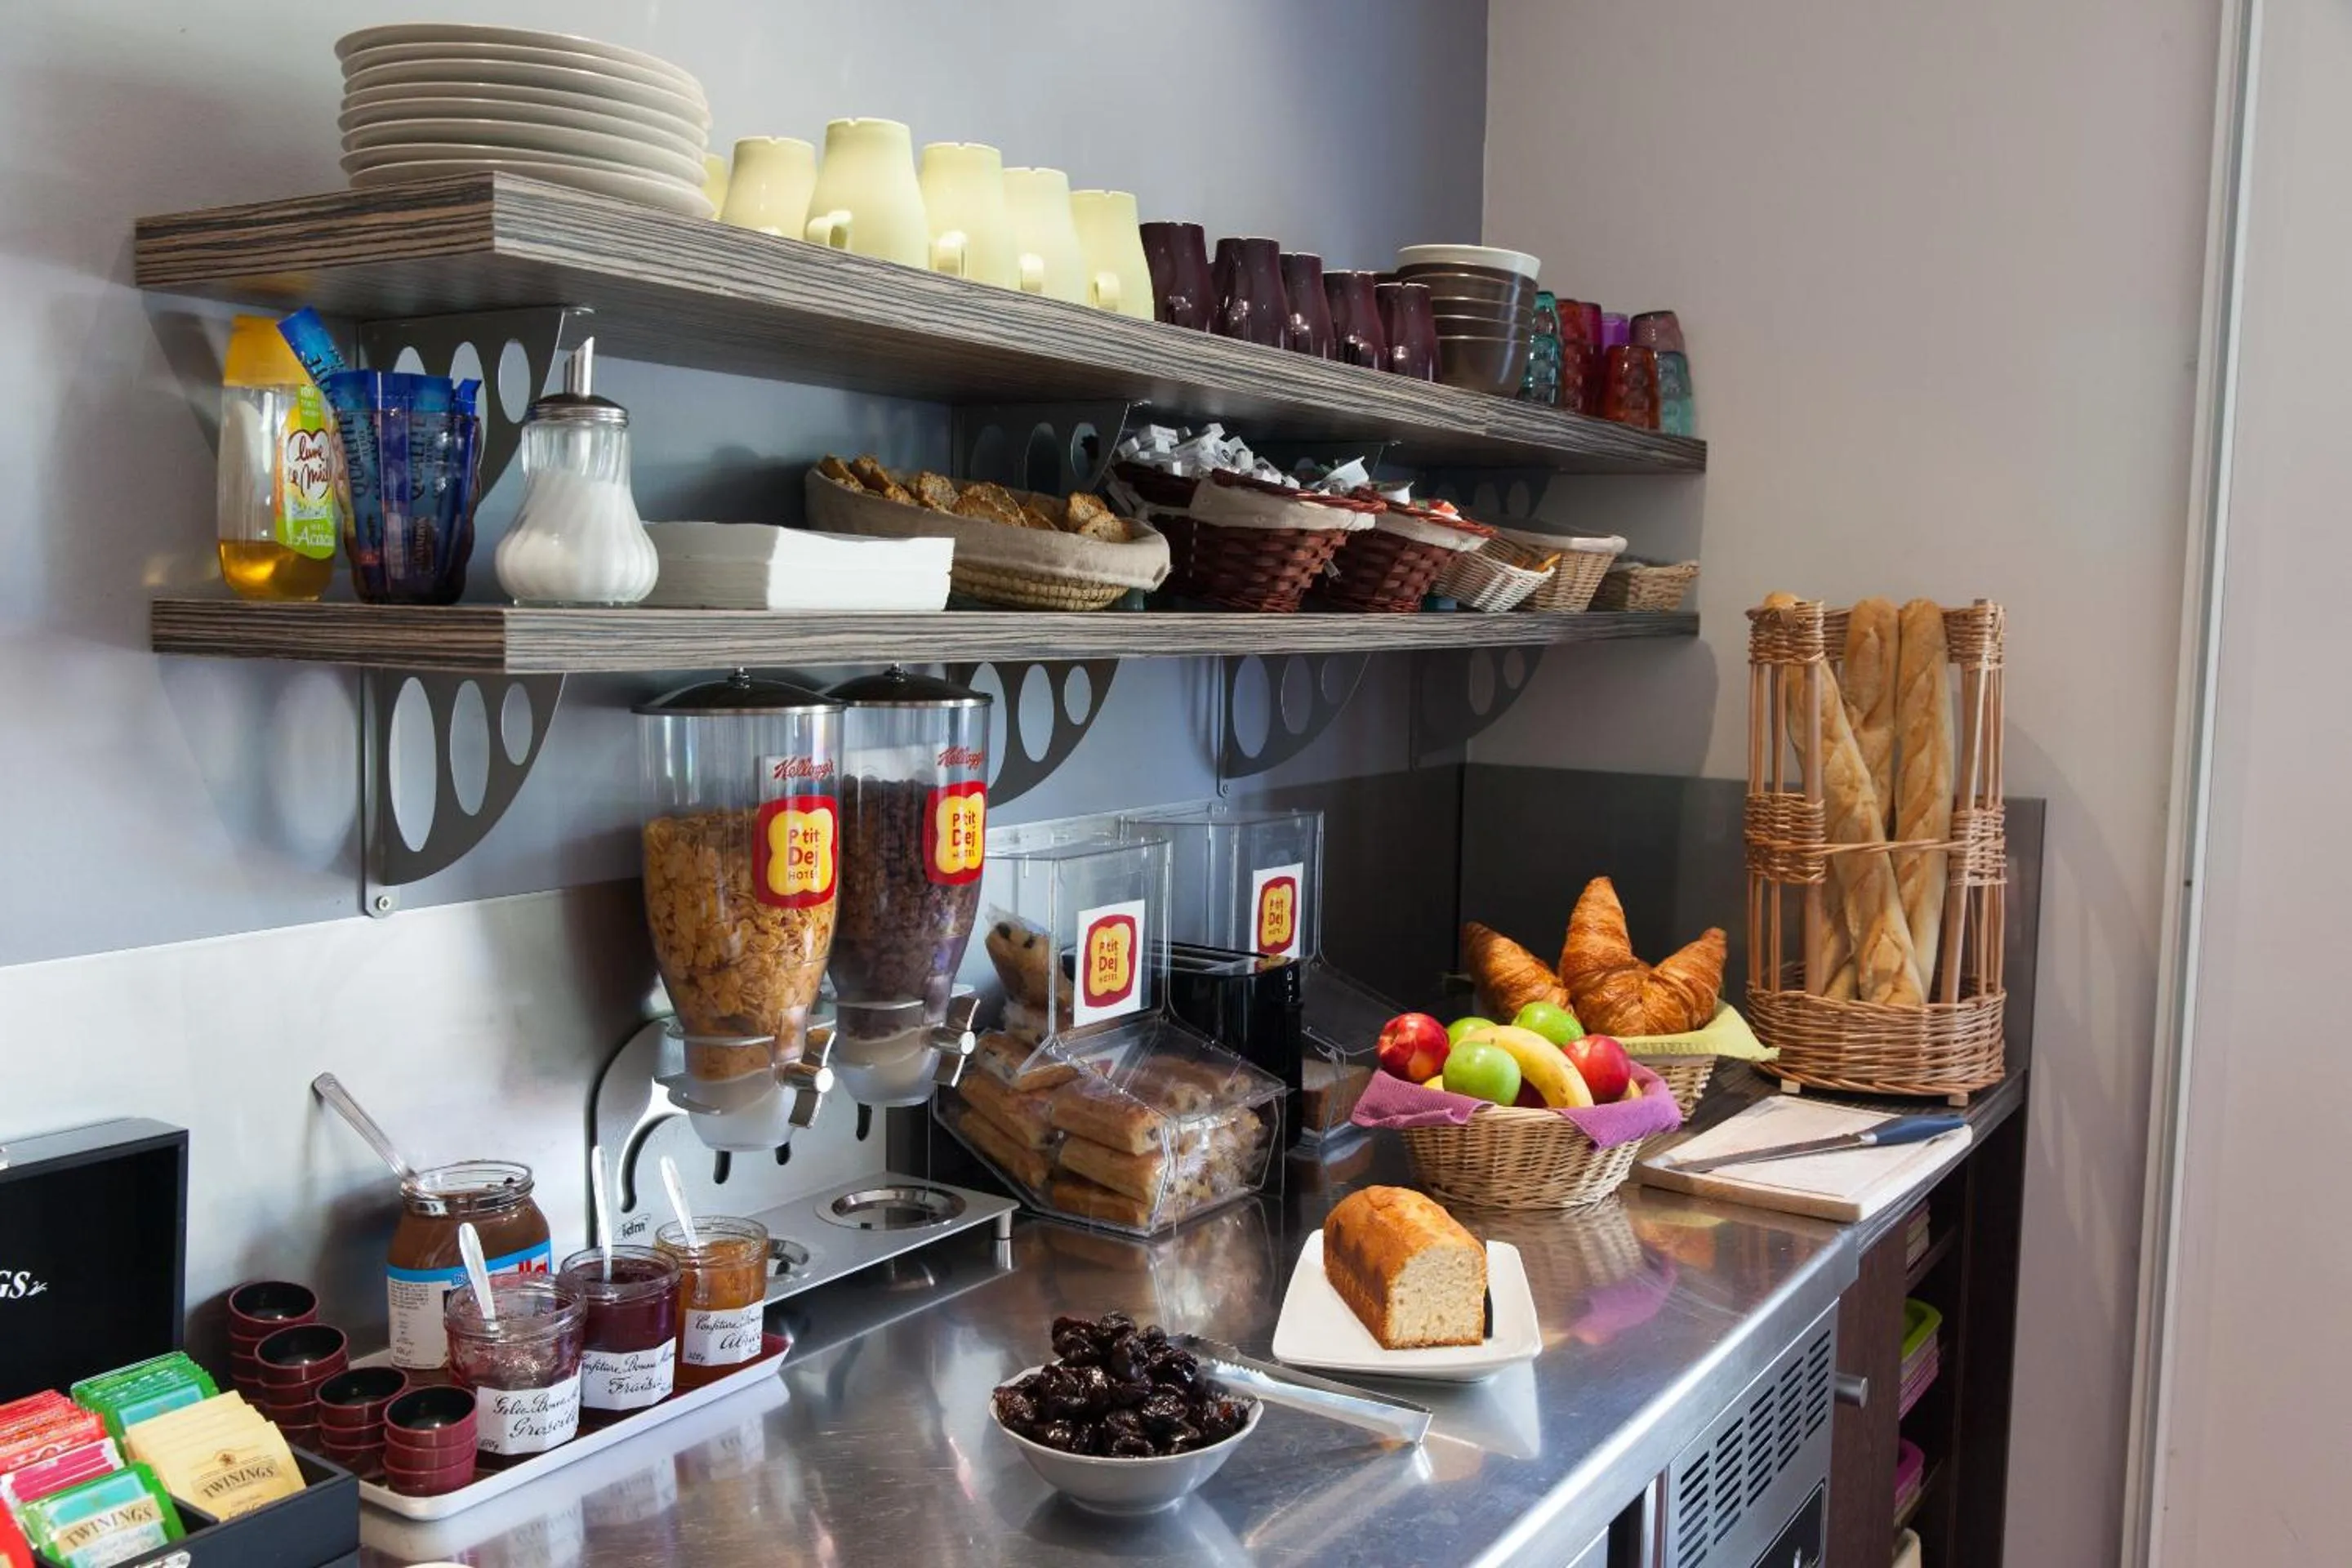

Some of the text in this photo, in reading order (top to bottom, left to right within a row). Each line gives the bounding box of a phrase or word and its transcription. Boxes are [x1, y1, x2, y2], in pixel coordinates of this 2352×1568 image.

[788, 844, 819, 868] Dej
[202, 1466, 274, 1499] TWININGS
[66, 1504, 153, 1548] TWININGS
